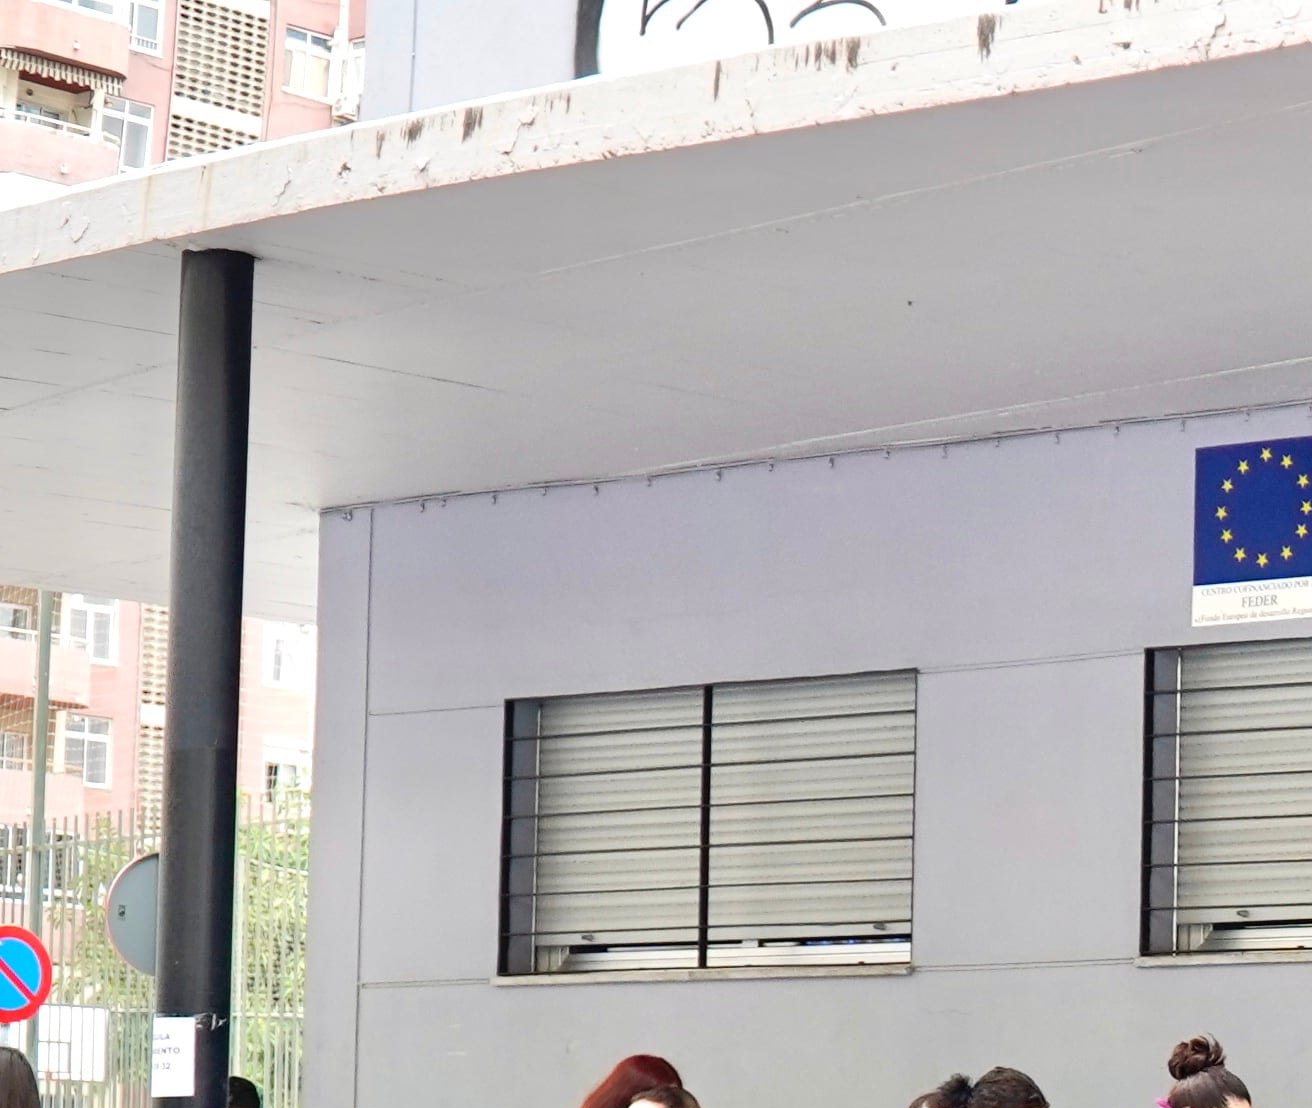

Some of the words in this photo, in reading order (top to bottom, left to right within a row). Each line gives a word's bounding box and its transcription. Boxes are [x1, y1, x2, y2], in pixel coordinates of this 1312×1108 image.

[1201, 585, 1232, 597] CENTRO
[1233, 581, 1293, 595] COFINANCIADO
[1294, 580, 1310, 589] POR
[1241, 594, 1279, 609] FEDER
